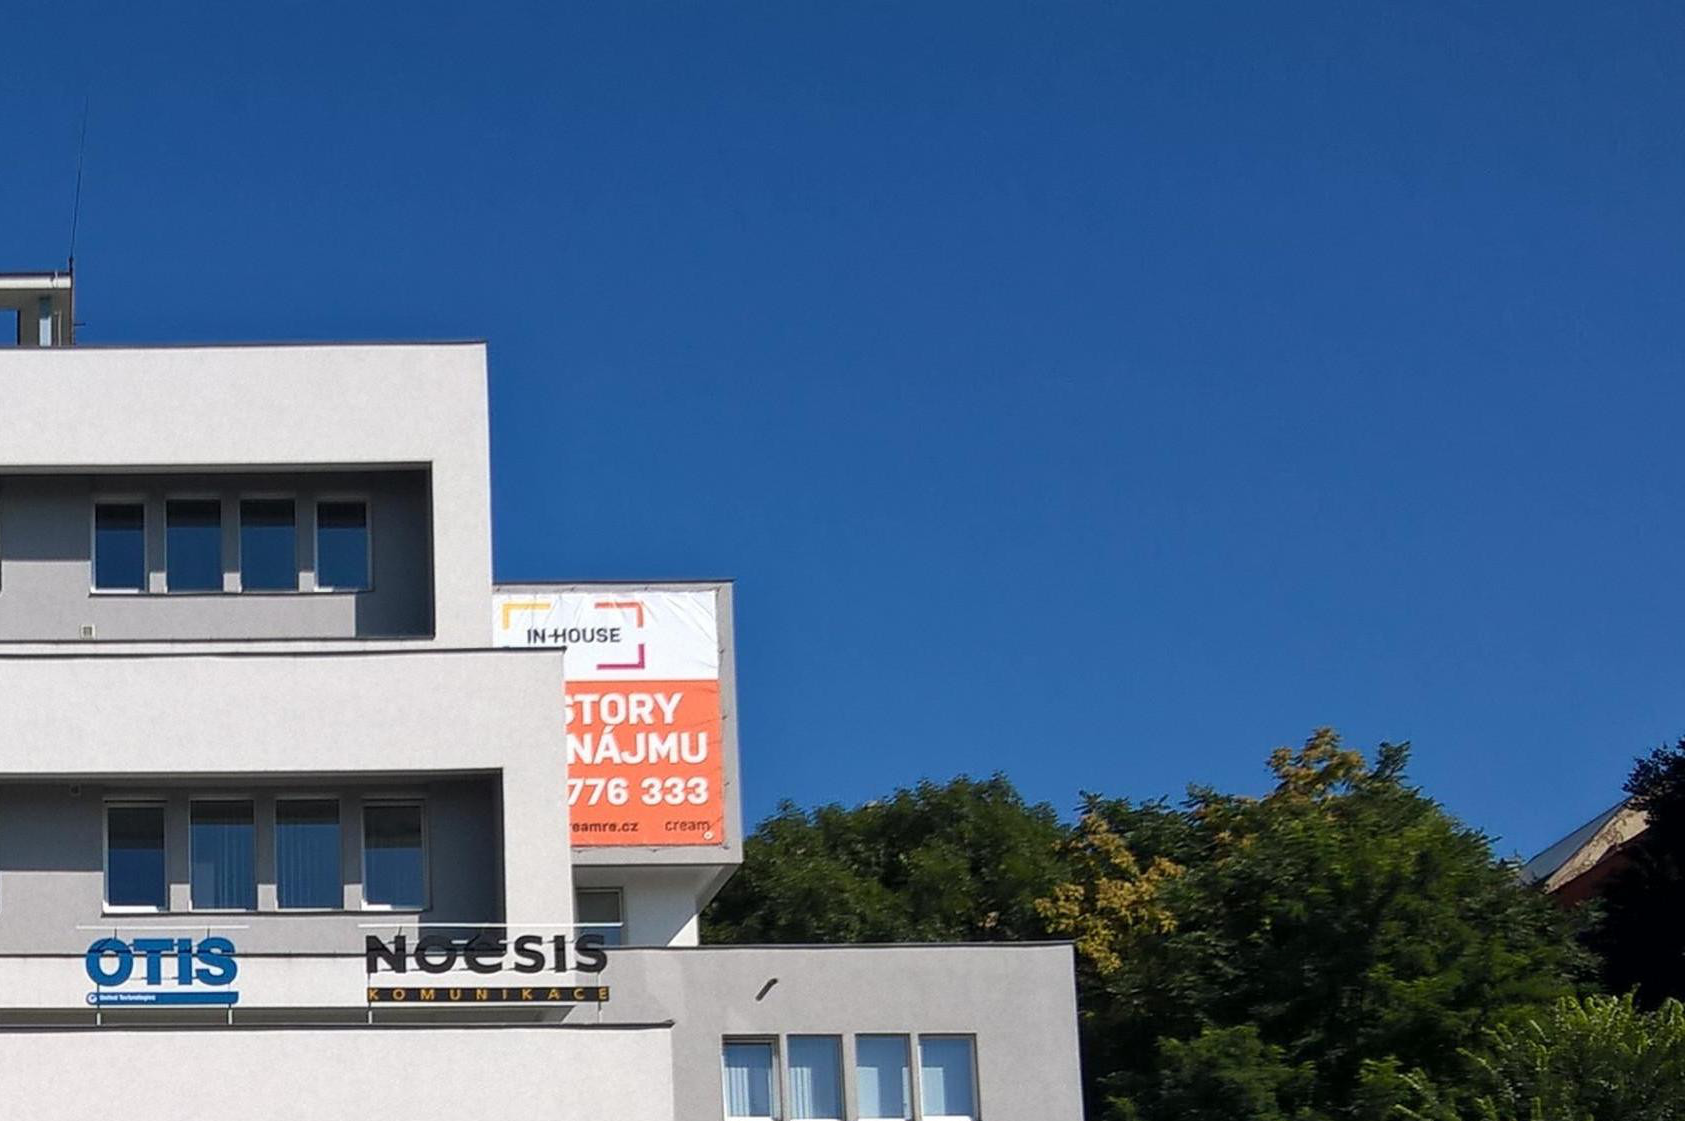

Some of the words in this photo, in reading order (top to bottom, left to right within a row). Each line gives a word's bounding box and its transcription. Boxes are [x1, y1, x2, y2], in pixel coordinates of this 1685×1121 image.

[527, 628, 621, 644] IN-HOUSE
[567, 725, 708, 765] NÁJMU
[641, 777, 709, 805] 333
[570, 821, 638, 832] eamre.cz
[86, 937, 238, 986] OTIS
[368, 987, 609, 1001] KOMUNIKACE
